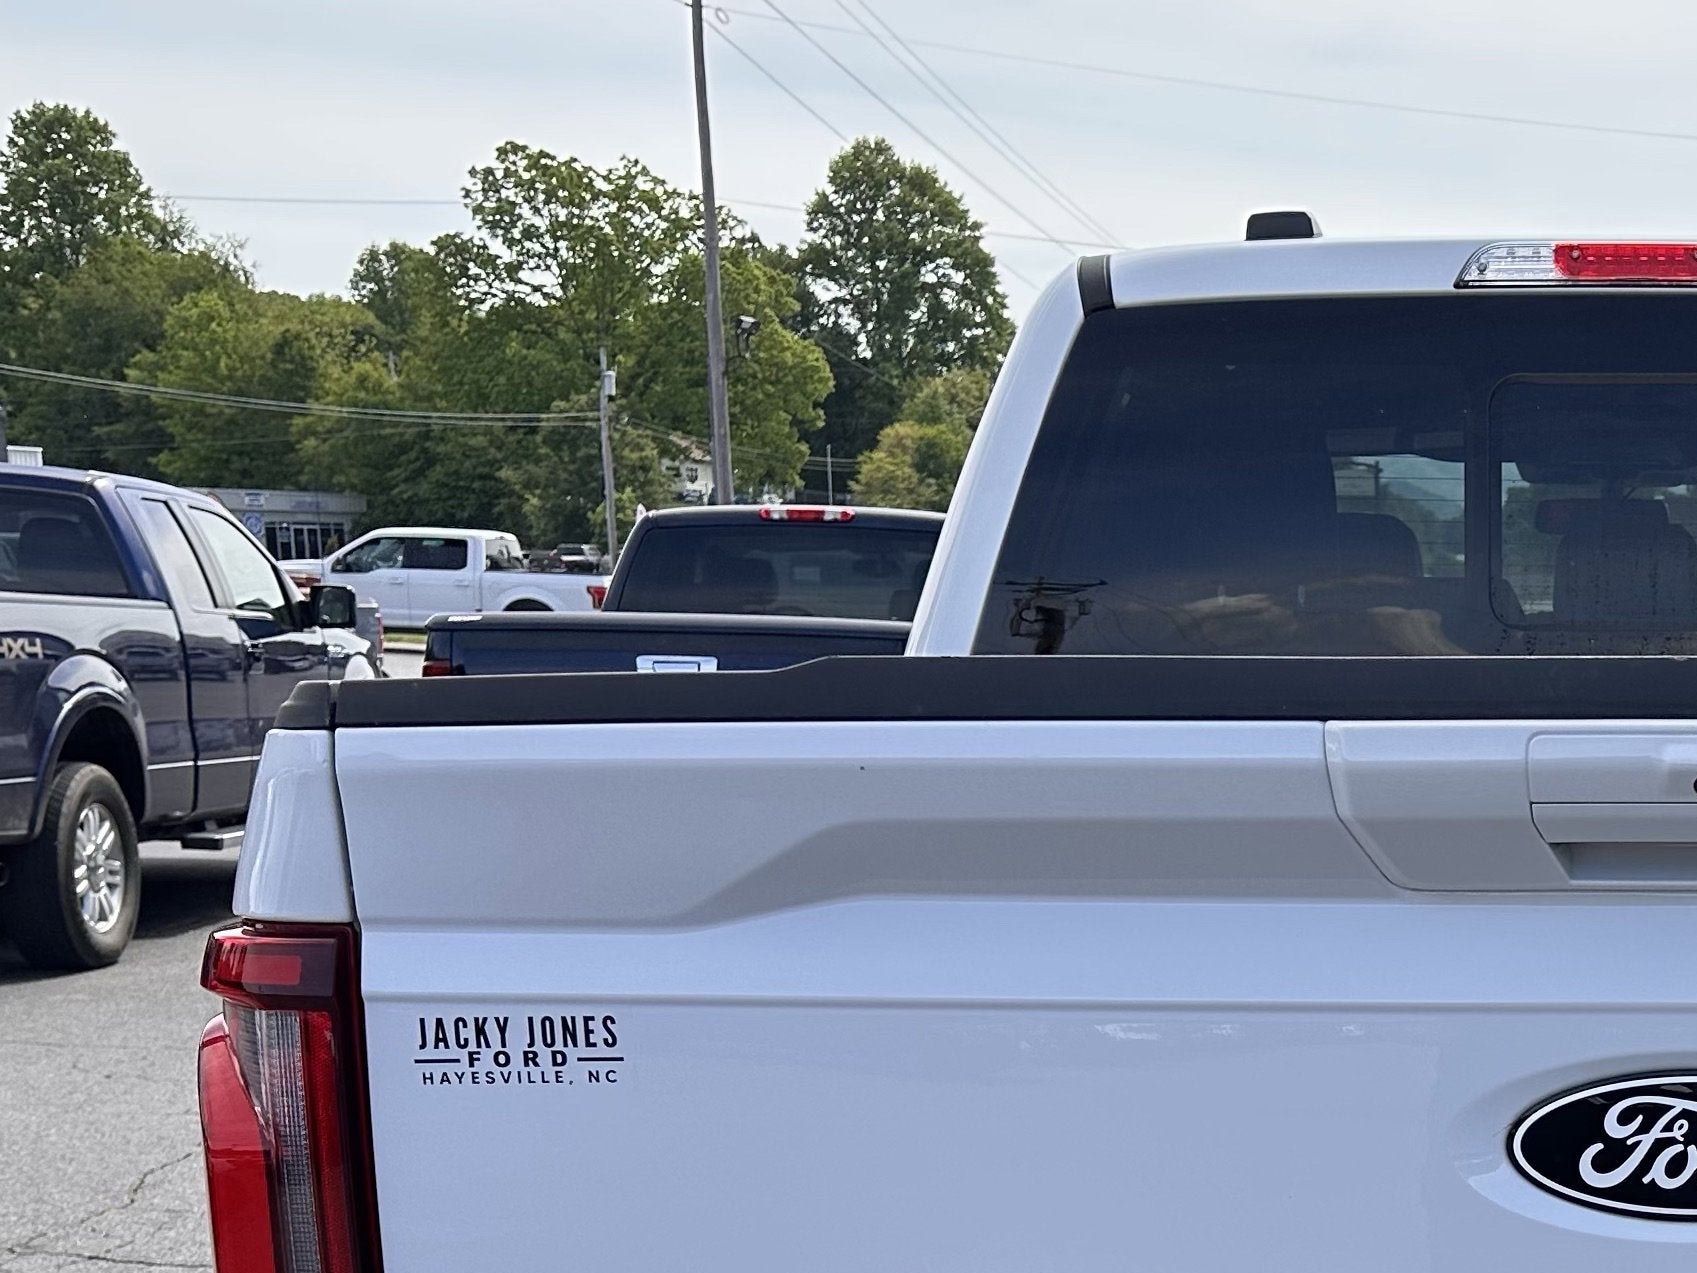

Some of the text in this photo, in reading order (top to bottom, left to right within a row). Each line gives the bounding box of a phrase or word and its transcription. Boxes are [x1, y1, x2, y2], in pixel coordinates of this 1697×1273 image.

[418, 1015, 618, 1051] JACKY JONES
[467, 1050, 569, 1069] FORD
[422, 1069, 618, 1086] HAYESVILLE, NC
